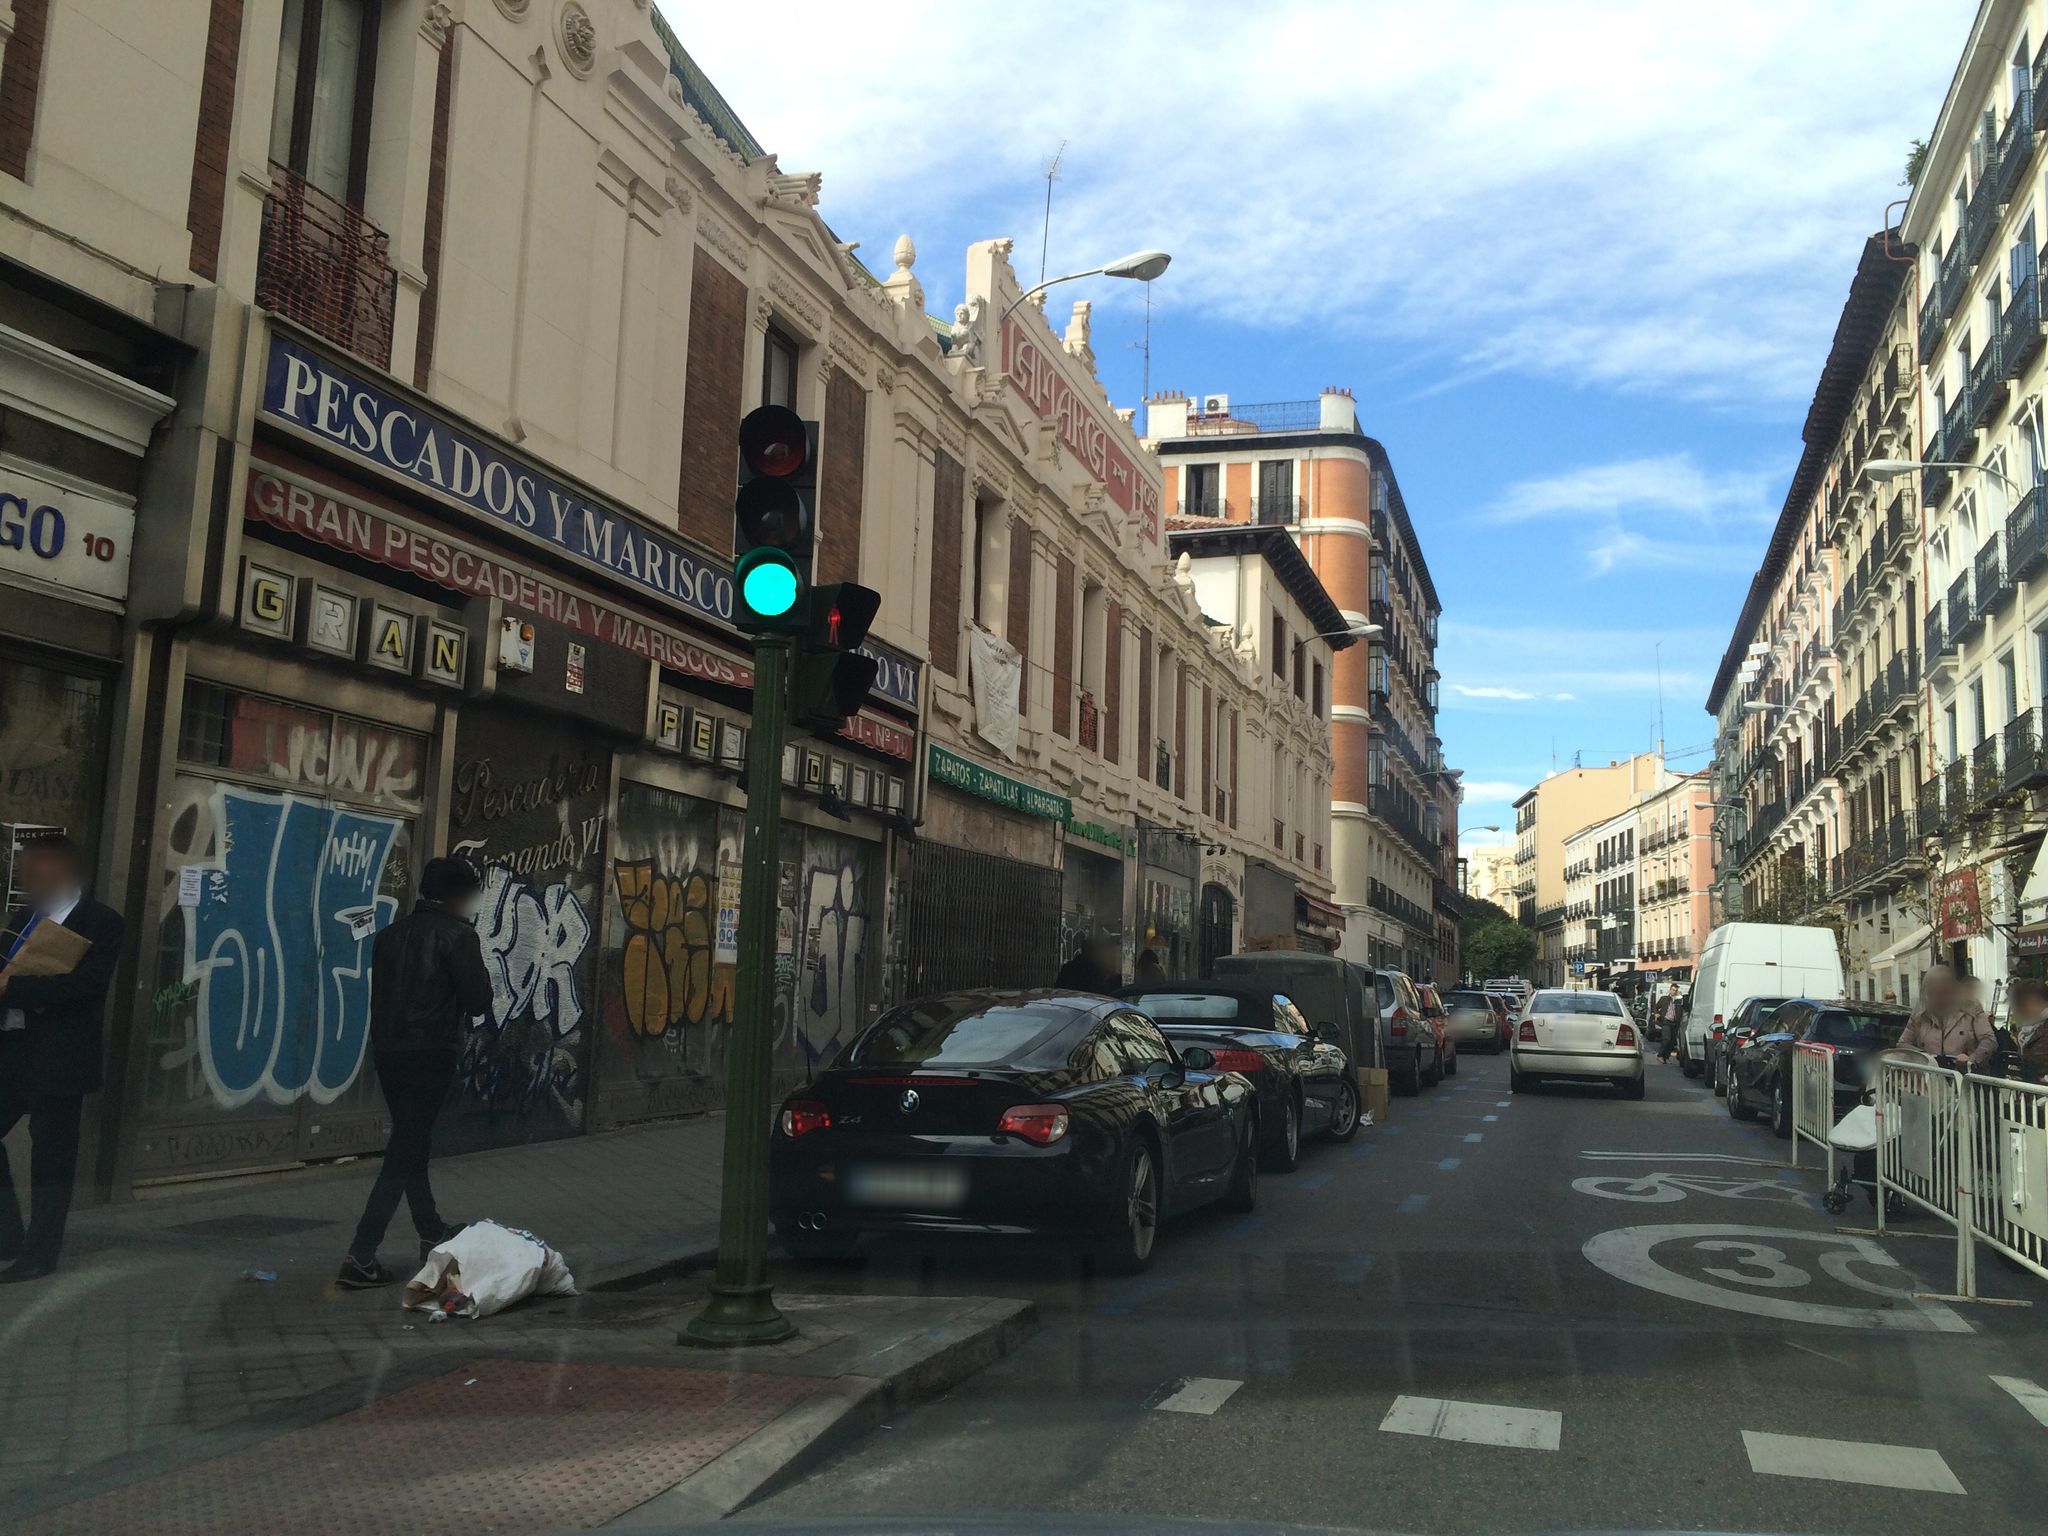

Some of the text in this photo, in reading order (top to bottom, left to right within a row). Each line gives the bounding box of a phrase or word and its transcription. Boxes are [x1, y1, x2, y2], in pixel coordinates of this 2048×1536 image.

[277, 352, 536, 528] PESCADOS
[547, 489, 573, 545] Y
[83, 532, 115, 562] 10
[253, 474, 373, 551] GRAN
[384, 521, 582, 630] PESCADERIA
[590, 604, 607, 637] Y
[611, 613, 735, 683] MARISCOS
[254, 577, 459, 674] GRAN
[896, 662, 916, 702] VI
[935, 752, 971, 786] ZAPATOS
[979, 772, 1019, 804] ZAPATILLAS
